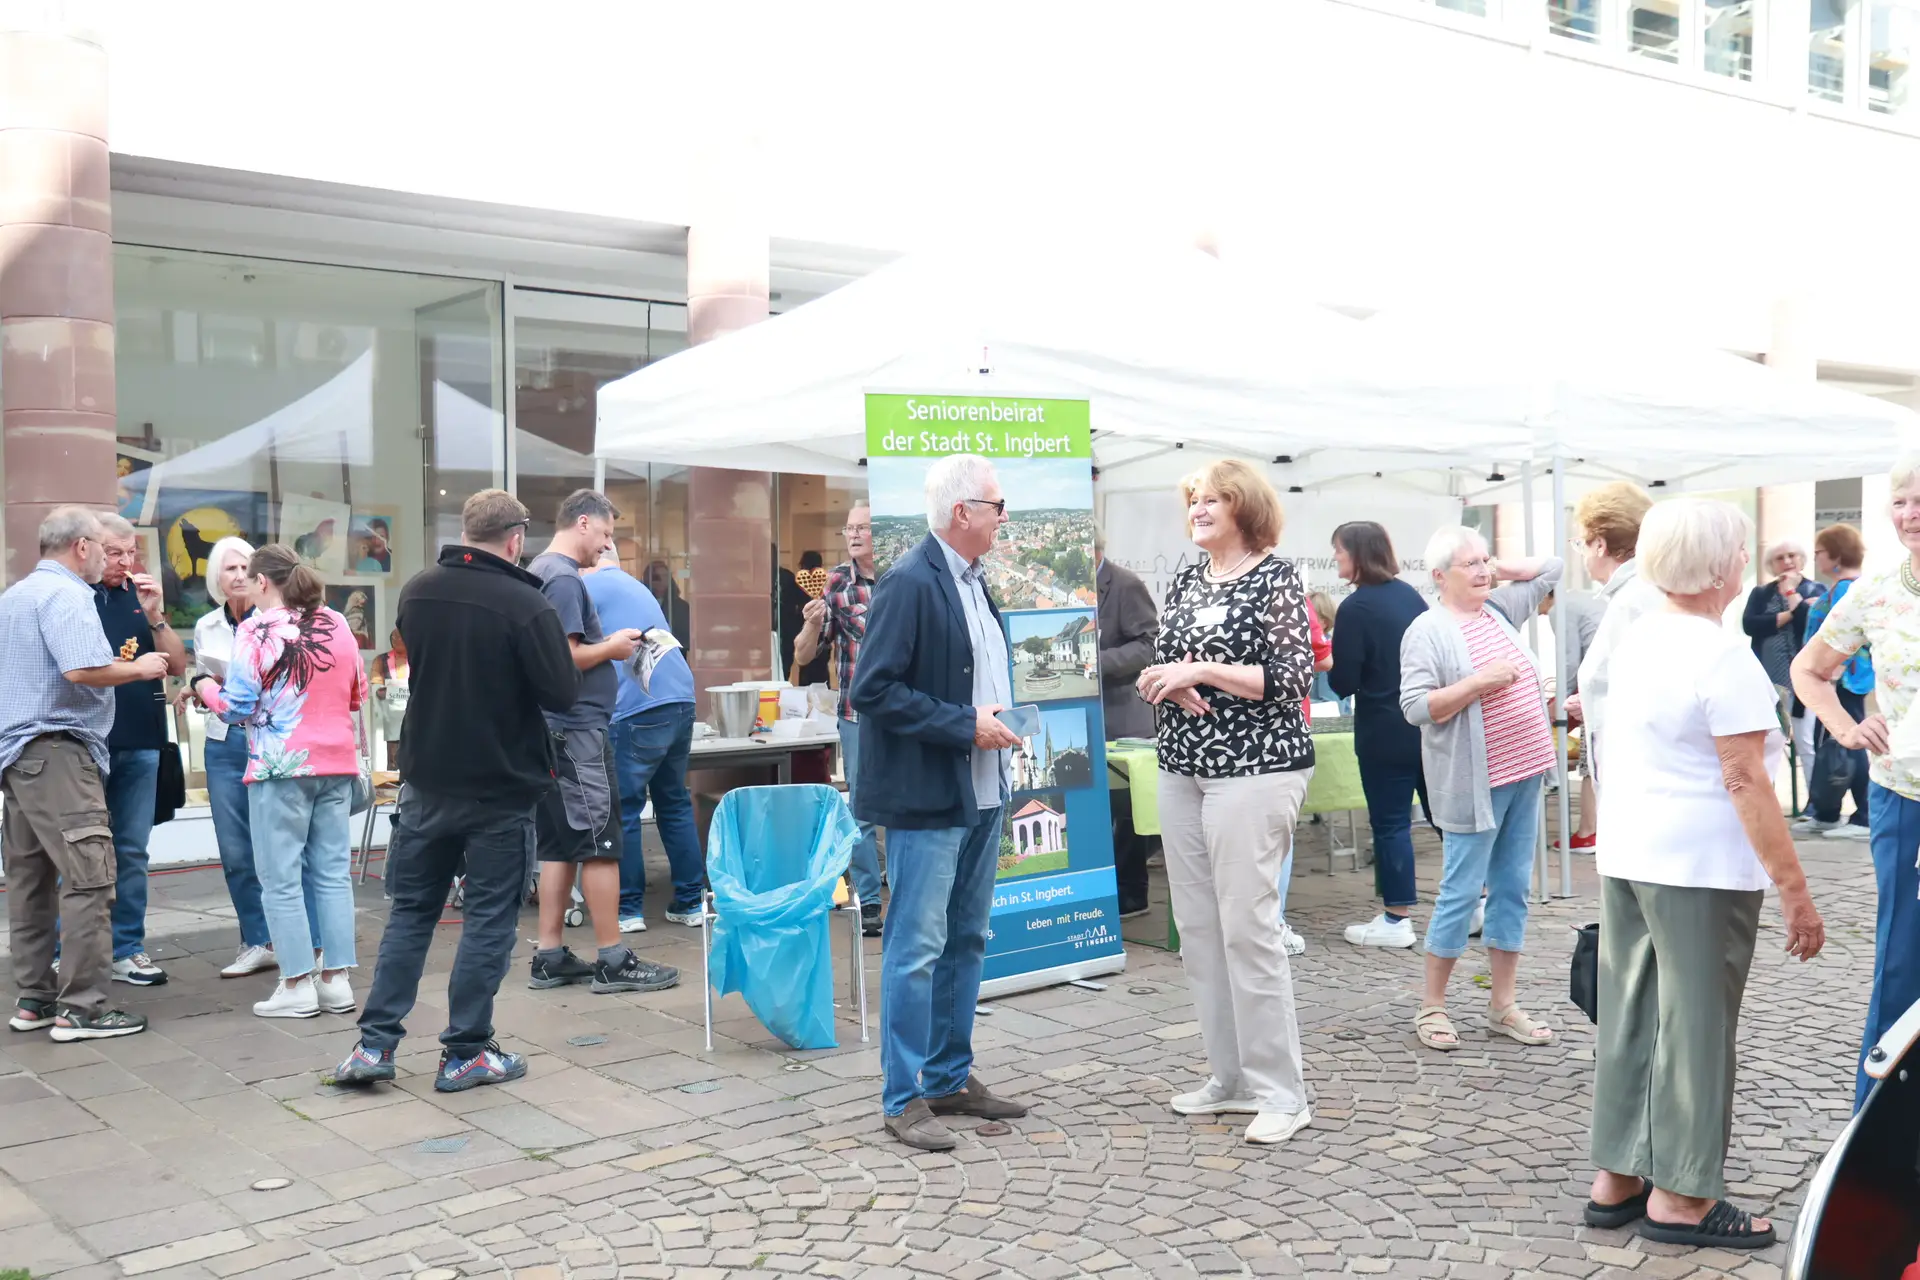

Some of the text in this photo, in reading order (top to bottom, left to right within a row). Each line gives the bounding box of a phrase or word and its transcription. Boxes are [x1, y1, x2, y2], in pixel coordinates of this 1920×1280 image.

[906, 399, 1045, 423] Seniorenbeirat
[882, 429, 1071, 457] der Stadt St. Ingbert
[991, 885, 1074, 908] ich in St. Ingbert.
[1026, 918, 1053, 930] Leben
[1056, 913, 1071, 925] mit
[1074, 907, 1105, 921] Freude.
[1074, 934, 1117, 949] ST INGBERT
